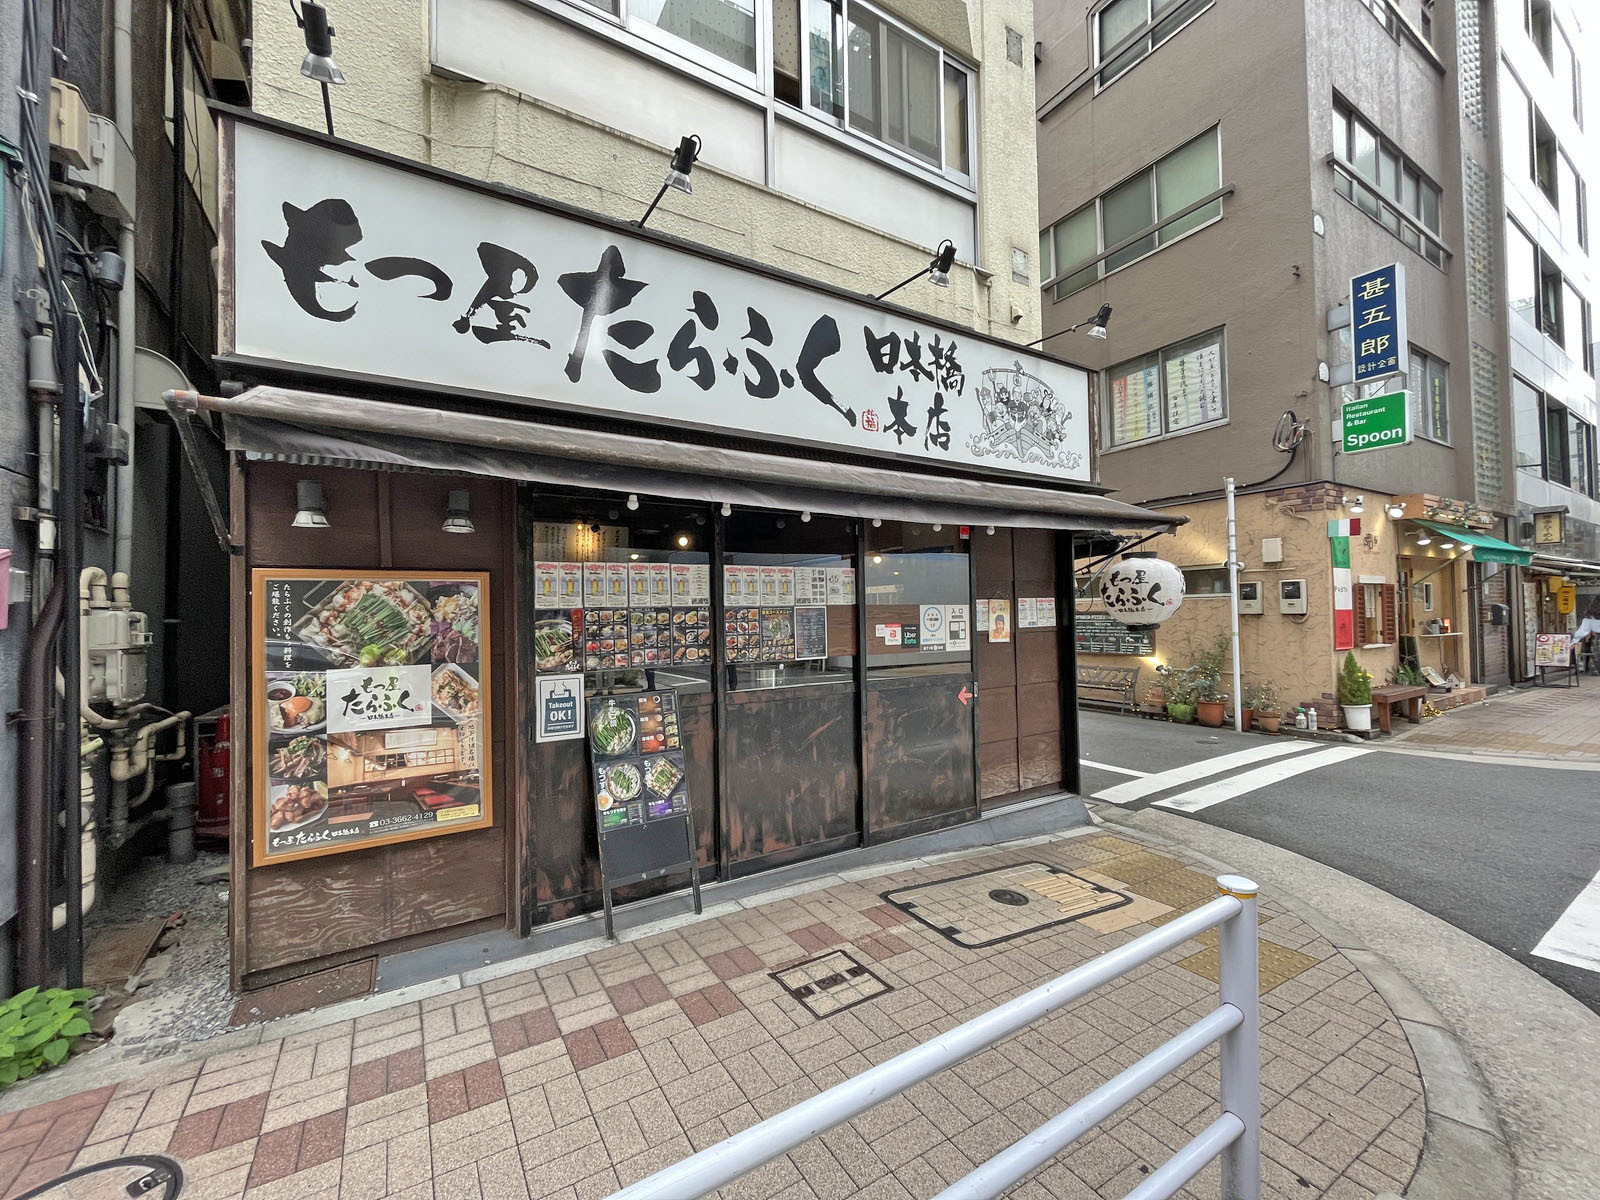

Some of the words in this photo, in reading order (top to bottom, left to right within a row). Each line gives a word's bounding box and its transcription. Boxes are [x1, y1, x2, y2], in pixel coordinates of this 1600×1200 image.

[1357, 277, 1391, 357] 甚五郎
[864, 325, 965, 397] 日本橋
[1346, 403, 1368, 412] Italian
[1346, 406, 1386, 420] Restaurant
[883, 385, 951, 452] 本店
[1347, 427, 1402, 446] Spoon
[1110, 570, 1149, 586] もつ屋
[1101, 582, 1165, 608] たらふく
[361, 676, 401, 693] もつ屋
[341, 688, 415, 717] たらふく
[548, 701, 573, 709] Takeout
[550, 710, 572, 721] OK!
[380, 811, 434, 826] 03-3662-4129
